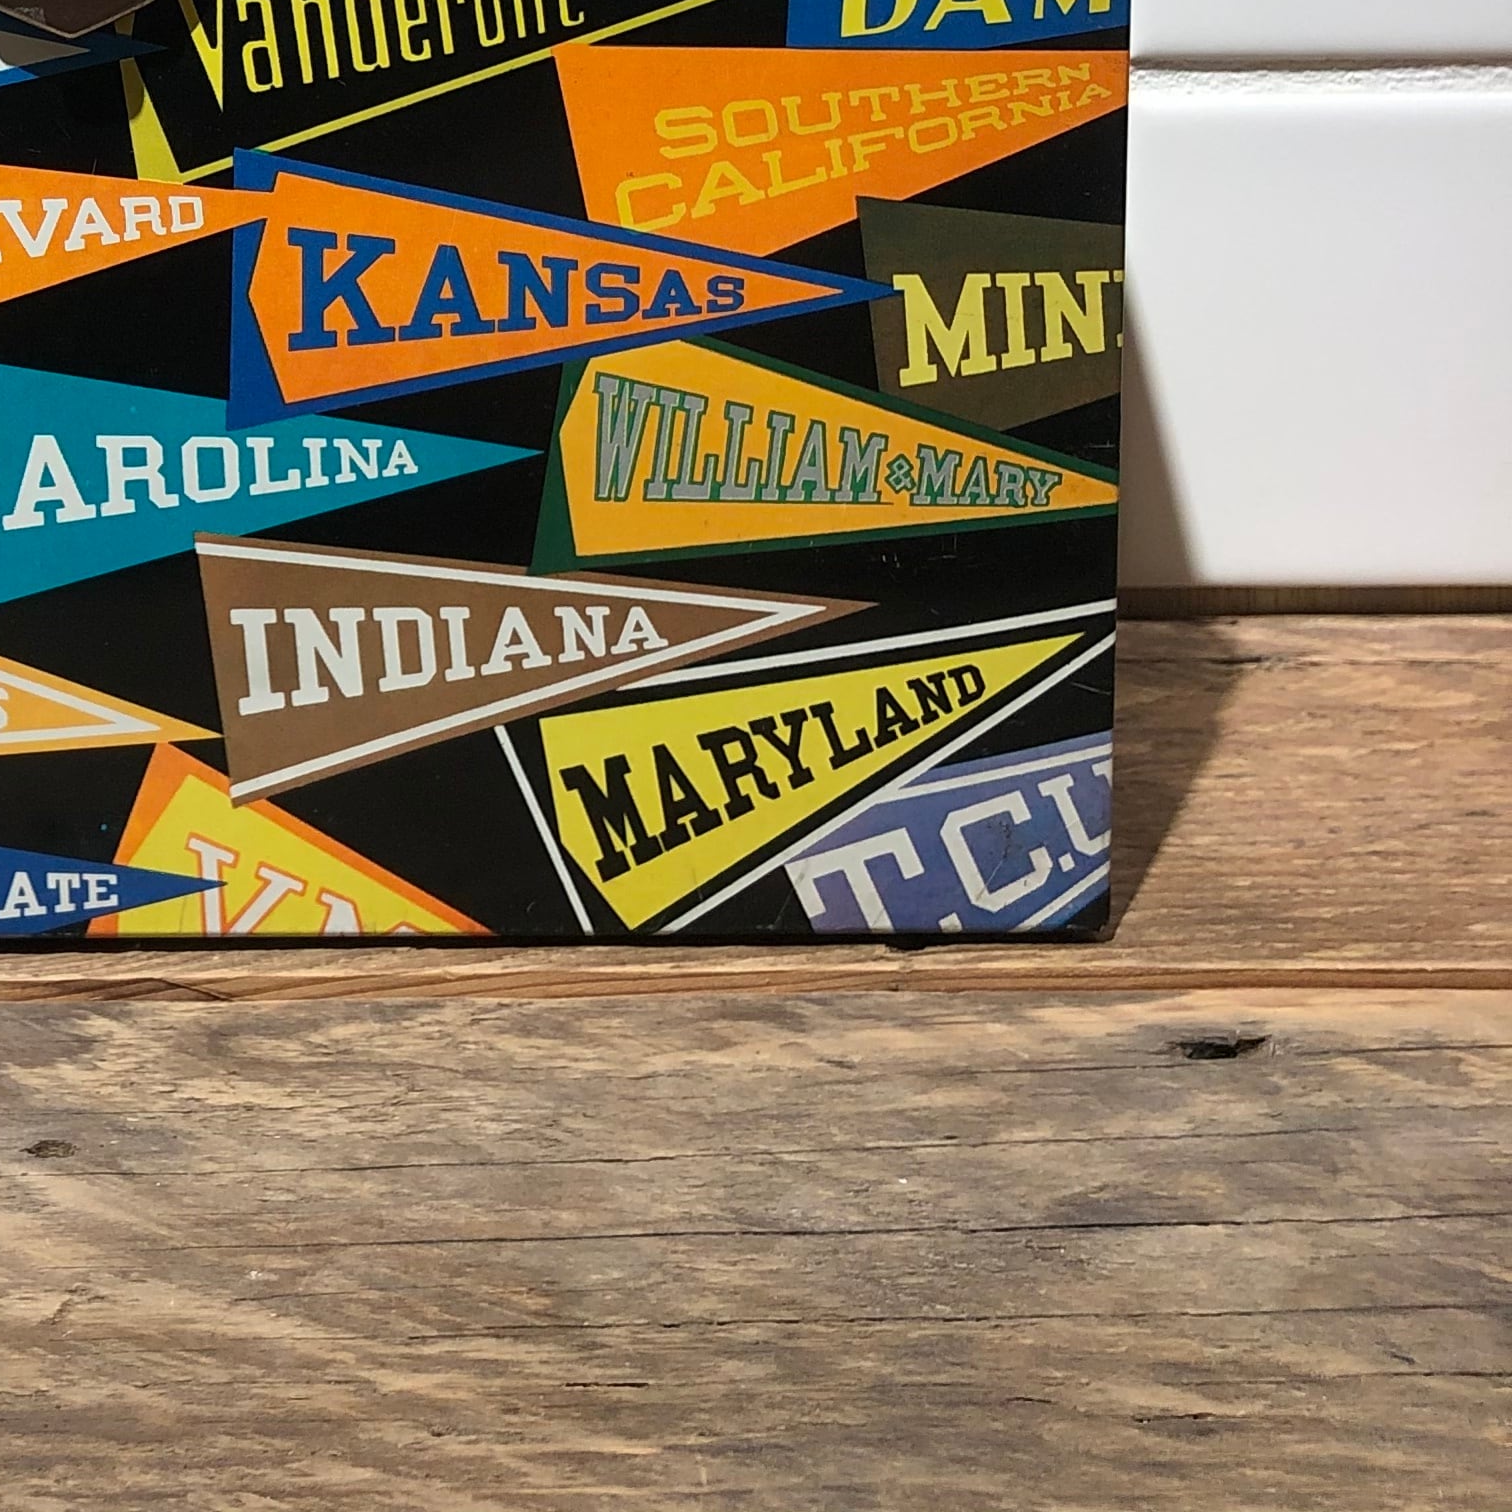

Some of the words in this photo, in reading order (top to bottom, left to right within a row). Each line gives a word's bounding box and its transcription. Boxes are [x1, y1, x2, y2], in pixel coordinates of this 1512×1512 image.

[614, 79, 1112, 232] CALIFORNIA
[653, 62, 1091, 159] SOUTHERN
[287, 226, 745, 352] KANSAS
[892, 269, 1124, 388] MIN
[230, 606, 669, 716] INDIANA
[559, 663, 987, 884] MARYLAND
